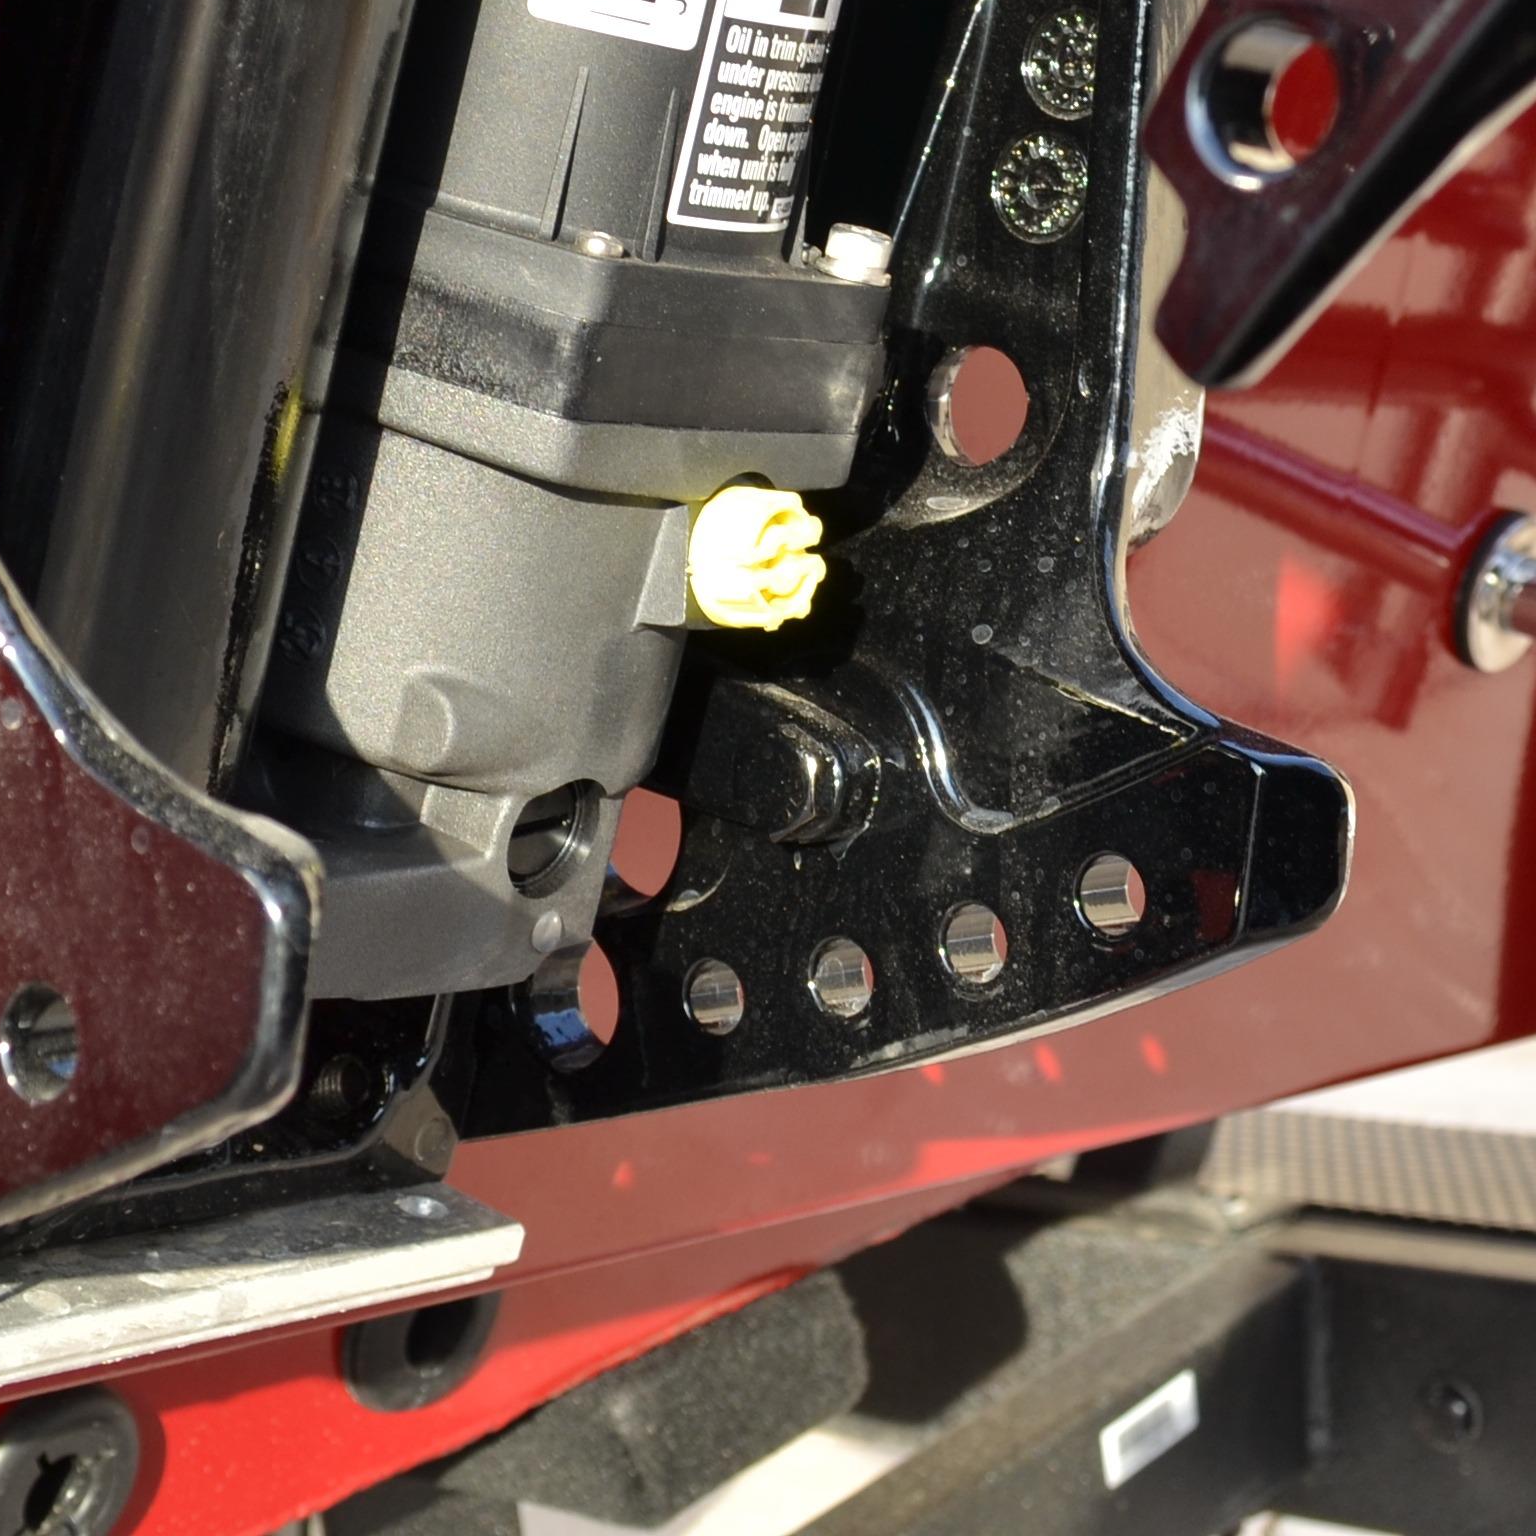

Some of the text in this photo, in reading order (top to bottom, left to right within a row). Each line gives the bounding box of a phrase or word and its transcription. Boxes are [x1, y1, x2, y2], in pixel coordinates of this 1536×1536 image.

[725, 24, 753, 55] Oil
[752, 29, 769, 58] in
[769, 33, 797, 62] trim
[717, 59, 766, 88] under
[710, 91, 764, 123] engine
[765, 94, 779, 121] is
[703, 117, 749, 149] down.
[757, 124, 788, 154] Open
[697, 149, 740, 178] when
[740, 156, 768, 182] unit
[767, 157, 778, 182] is
[689, 178, 754, 211] trimmed
[753, 190, 769, 217] up.
